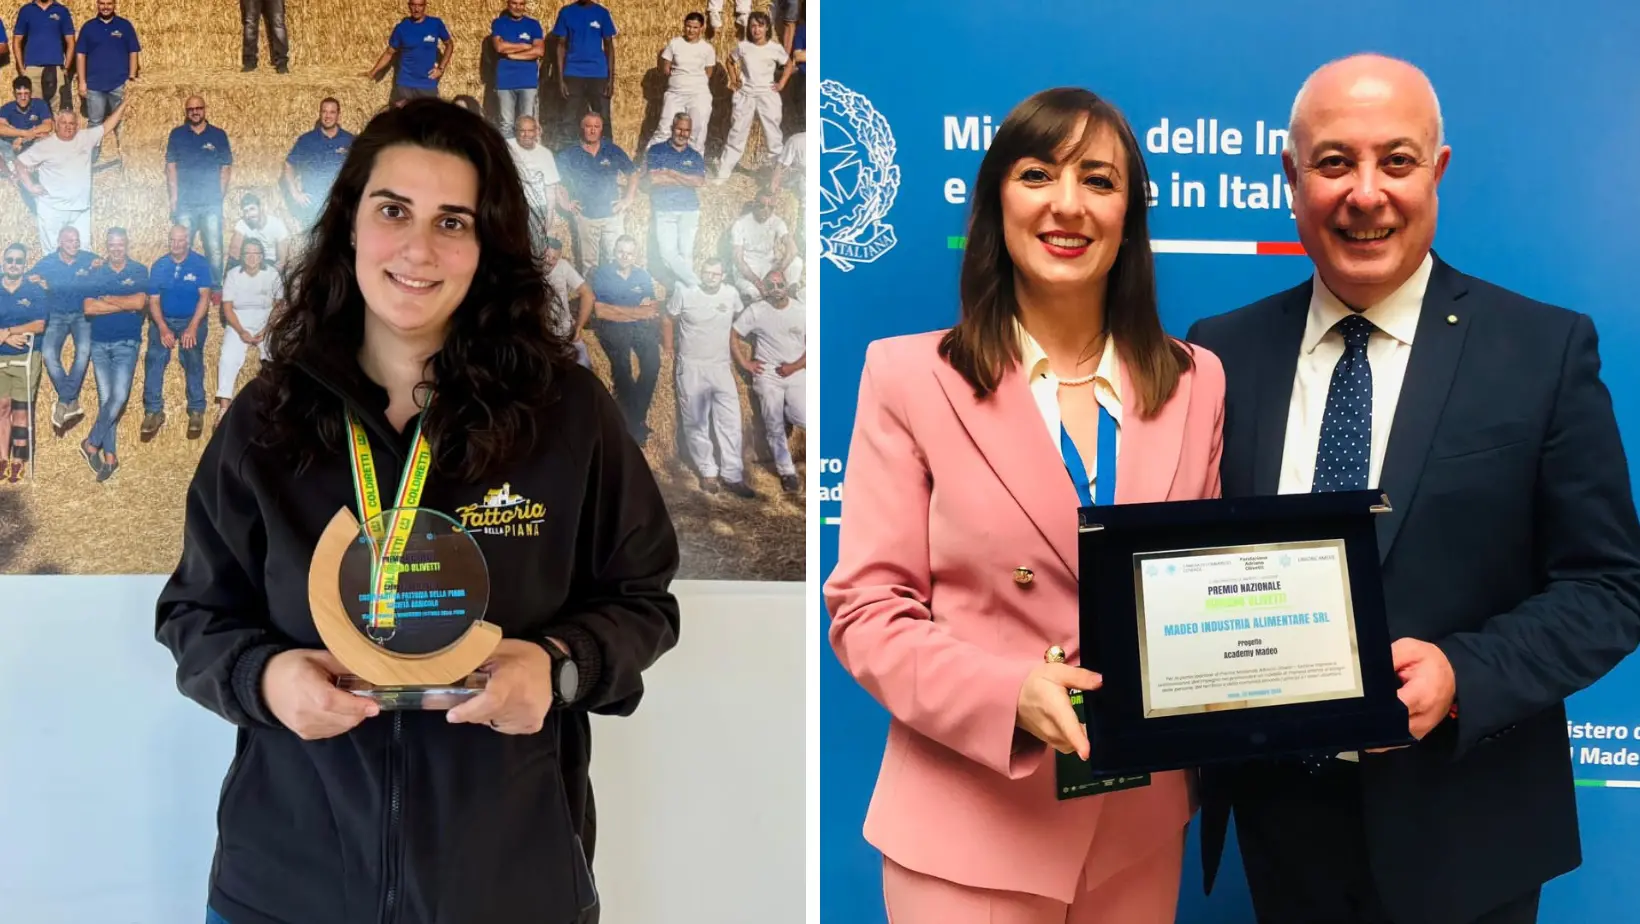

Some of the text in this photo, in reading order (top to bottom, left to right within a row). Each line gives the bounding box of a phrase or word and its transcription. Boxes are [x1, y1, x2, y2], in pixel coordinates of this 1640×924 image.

[943, 115, 1001, 151] Mi
[1146, 117, 1243, 155] delle
[944, 177, 967, 204] e
[1171, 171, 1206, 208] in
[833, 234, 894, 259] ITALIANA
[360, 453, 378, 508] COLDIRETTI
[406, 451, 429, 505] COLDIRETTI
[452, 499, 546, 533] Fattoria
[484, 523, 540, 537] DELLA PIANA
[1208, 580, 1281, 595] PREMIO NAZIONALE
[1164, 612, 1330, 637] MADEO INDUSTRIA ALIMENTARE SRL
[1223, 647, 1278, 659] Academy Madeo
[1580, 747, 1640, 766] Made
